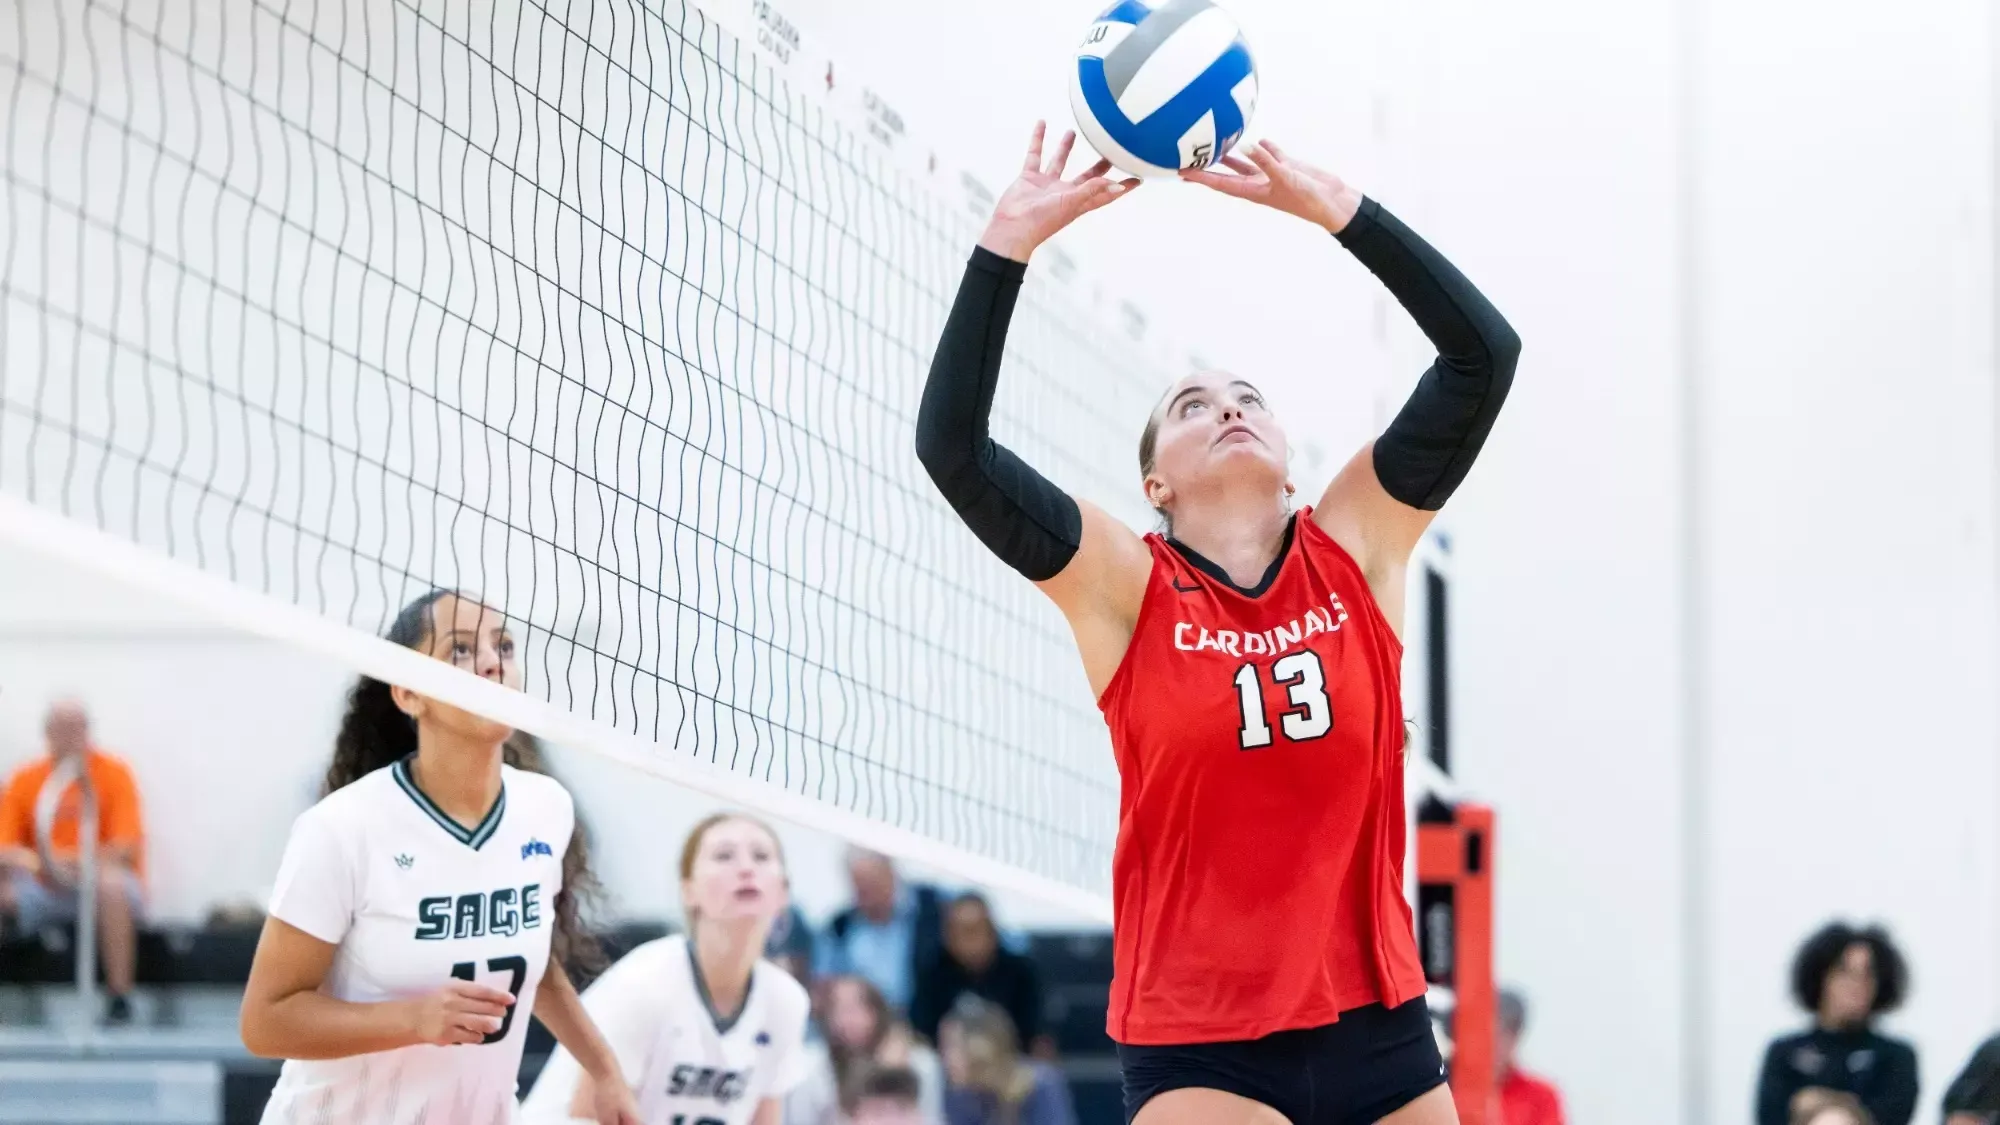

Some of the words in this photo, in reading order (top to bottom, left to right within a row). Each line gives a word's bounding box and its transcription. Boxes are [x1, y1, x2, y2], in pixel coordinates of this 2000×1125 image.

[1174, 591, 1349, 658] CARDINALS
[1232, 648, 1334, 751] 13
[415, 883, 541, 940] SAGE
